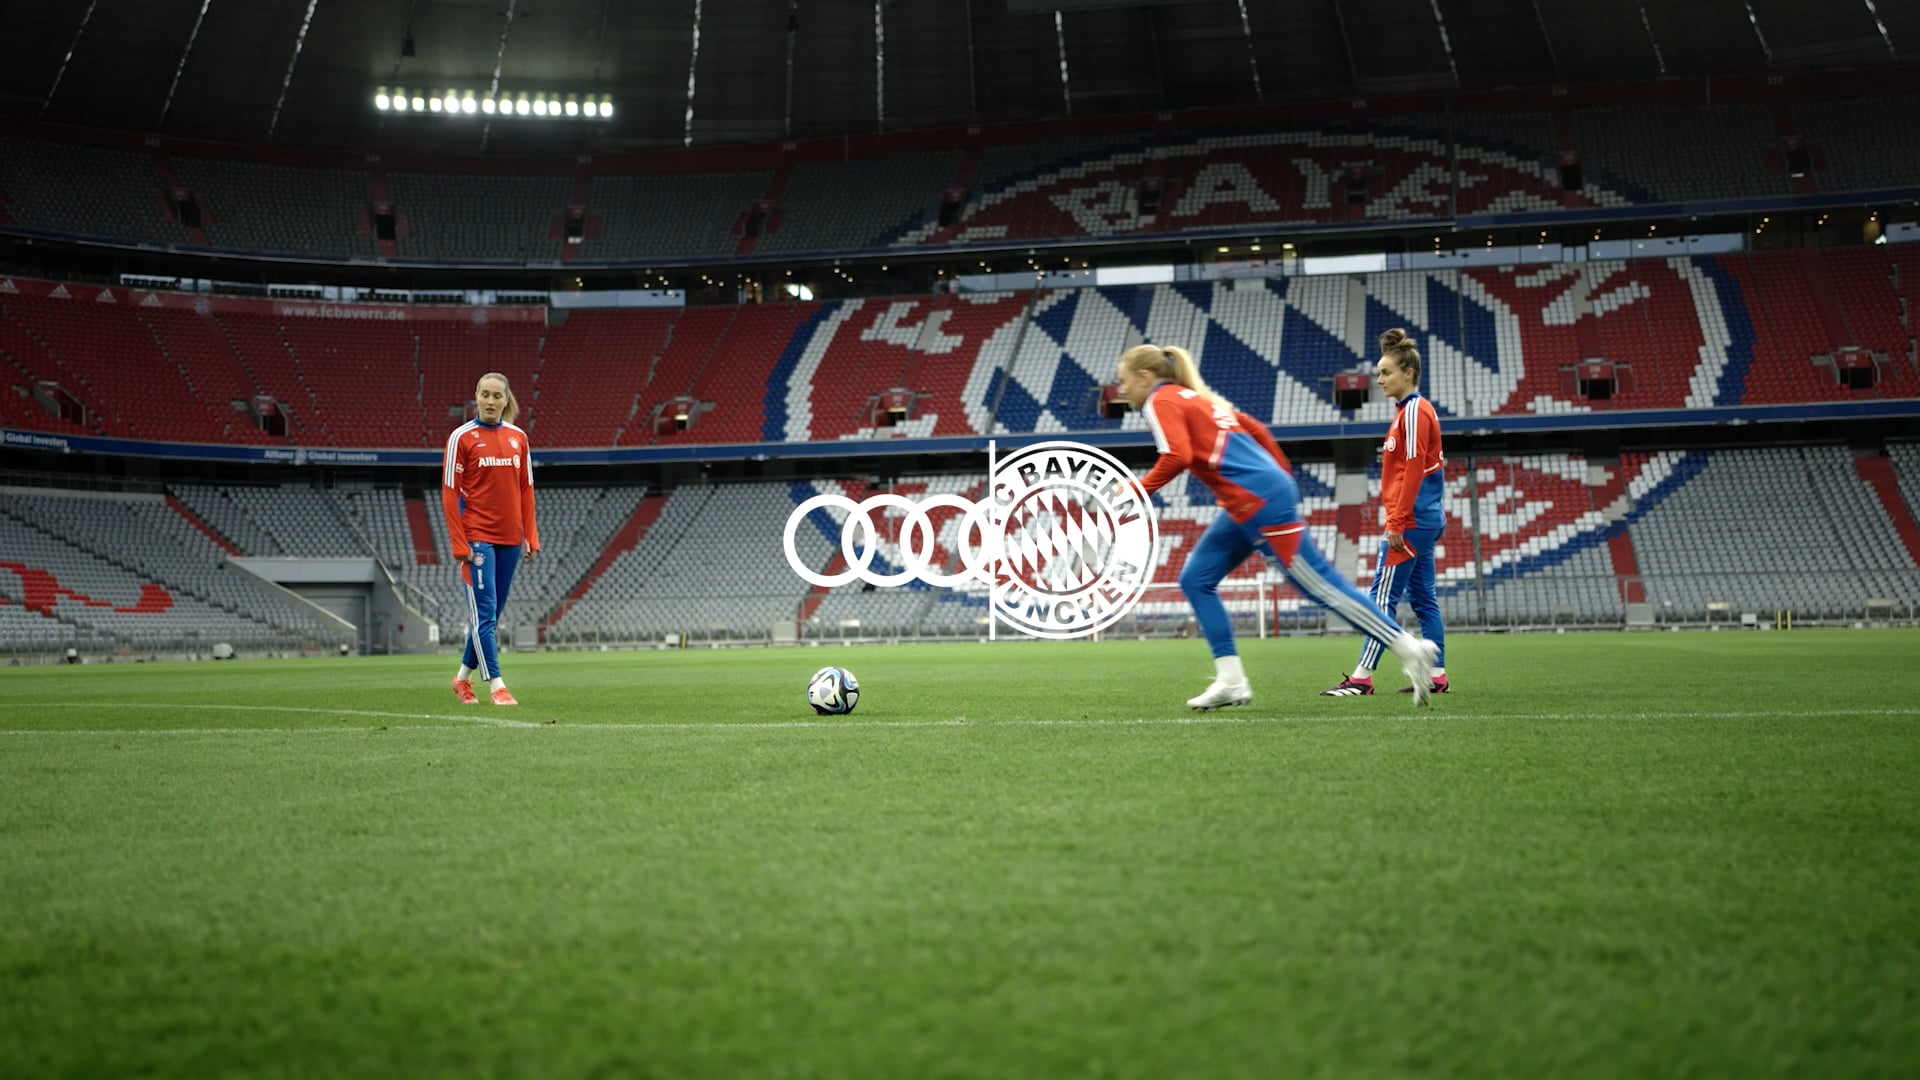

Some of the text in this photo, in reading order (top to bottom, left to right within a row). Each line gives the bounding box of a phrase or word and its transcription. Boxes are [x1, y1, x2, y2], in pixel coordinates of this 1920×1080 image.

[6, 432, 32, 443] Global
[264, 449, 294, 459] Allianz
[308, 451, 336, 461] Global
[478, 456, 512, 468] Allianz
